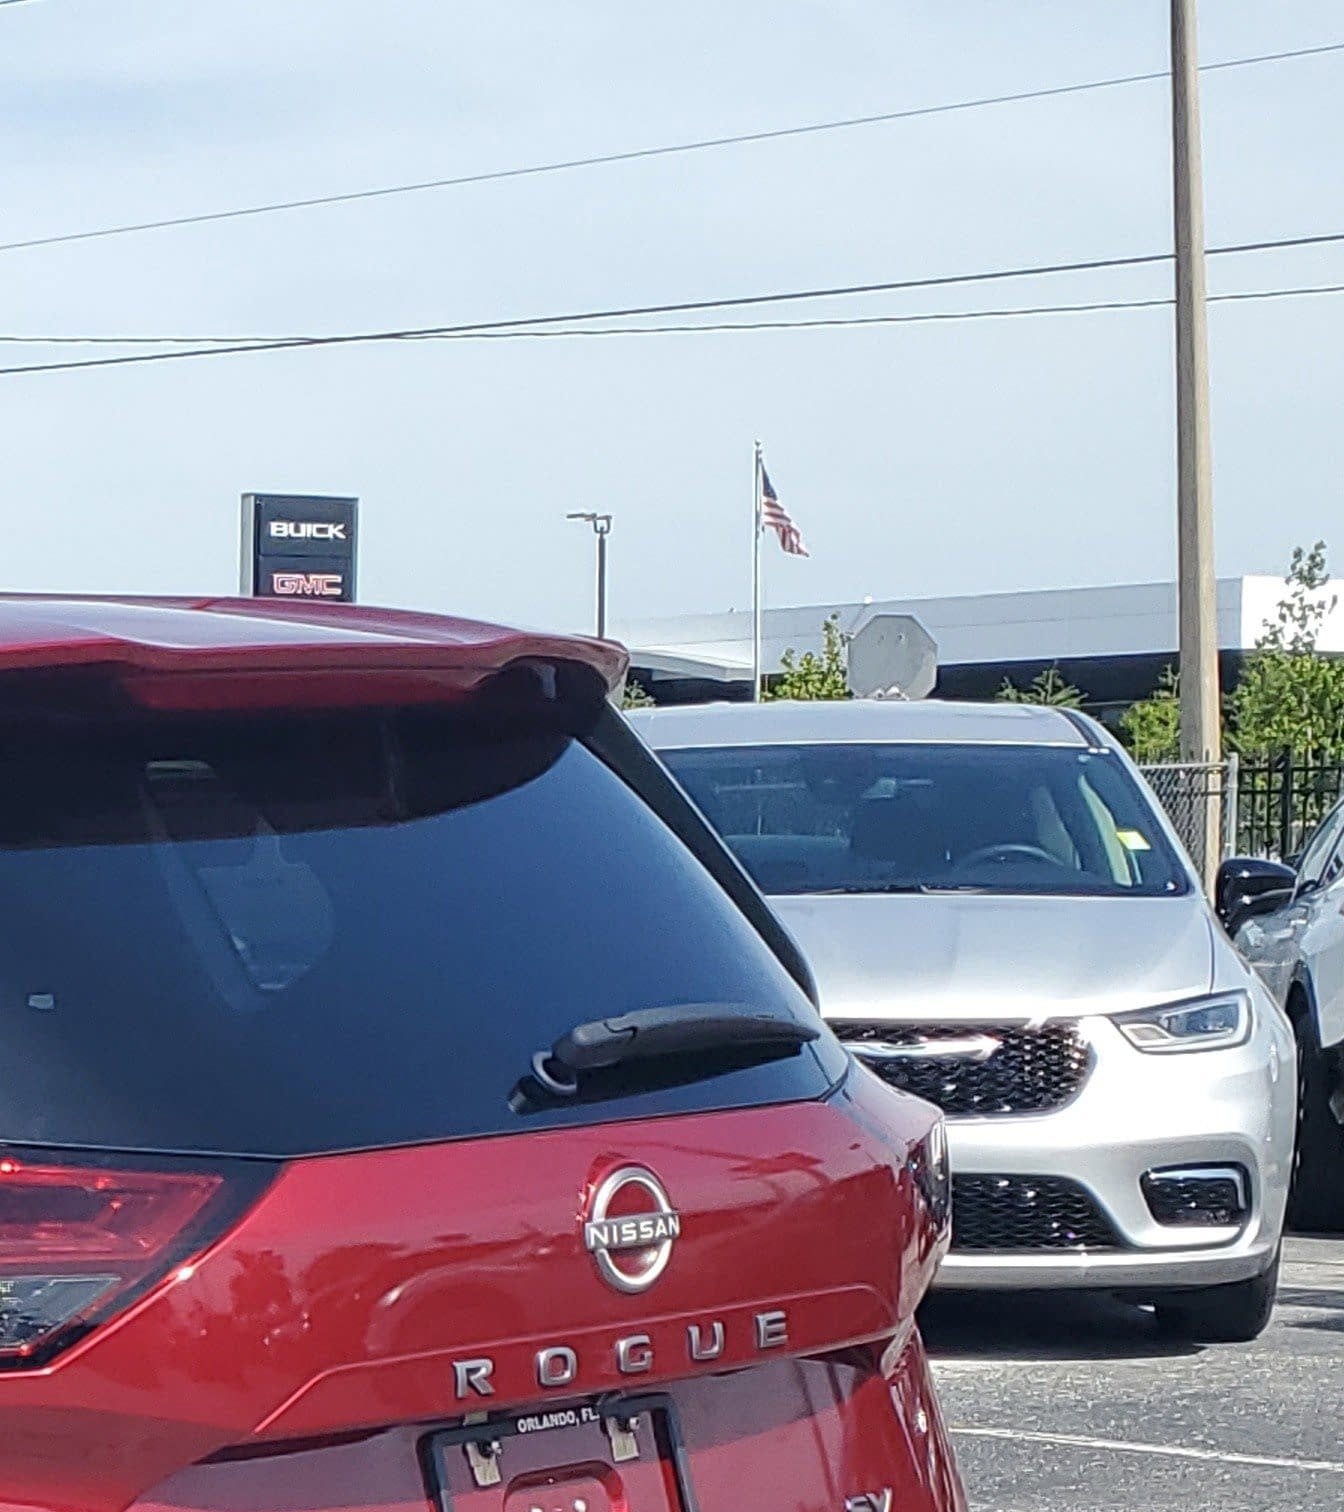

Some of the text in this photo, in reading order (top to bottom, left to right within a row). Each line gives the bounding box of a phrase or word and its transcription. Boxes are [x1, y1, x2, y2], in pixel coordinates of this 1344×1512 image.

[269, 520, 346, 539] BUICK
[272, 572, 342, 596] GMC
[589, 1215, 680, 1247] NISSAN
[453, 1311, 789, 1399] ROGUE
[517, 1410, 580, 1433] ORLANDO,
